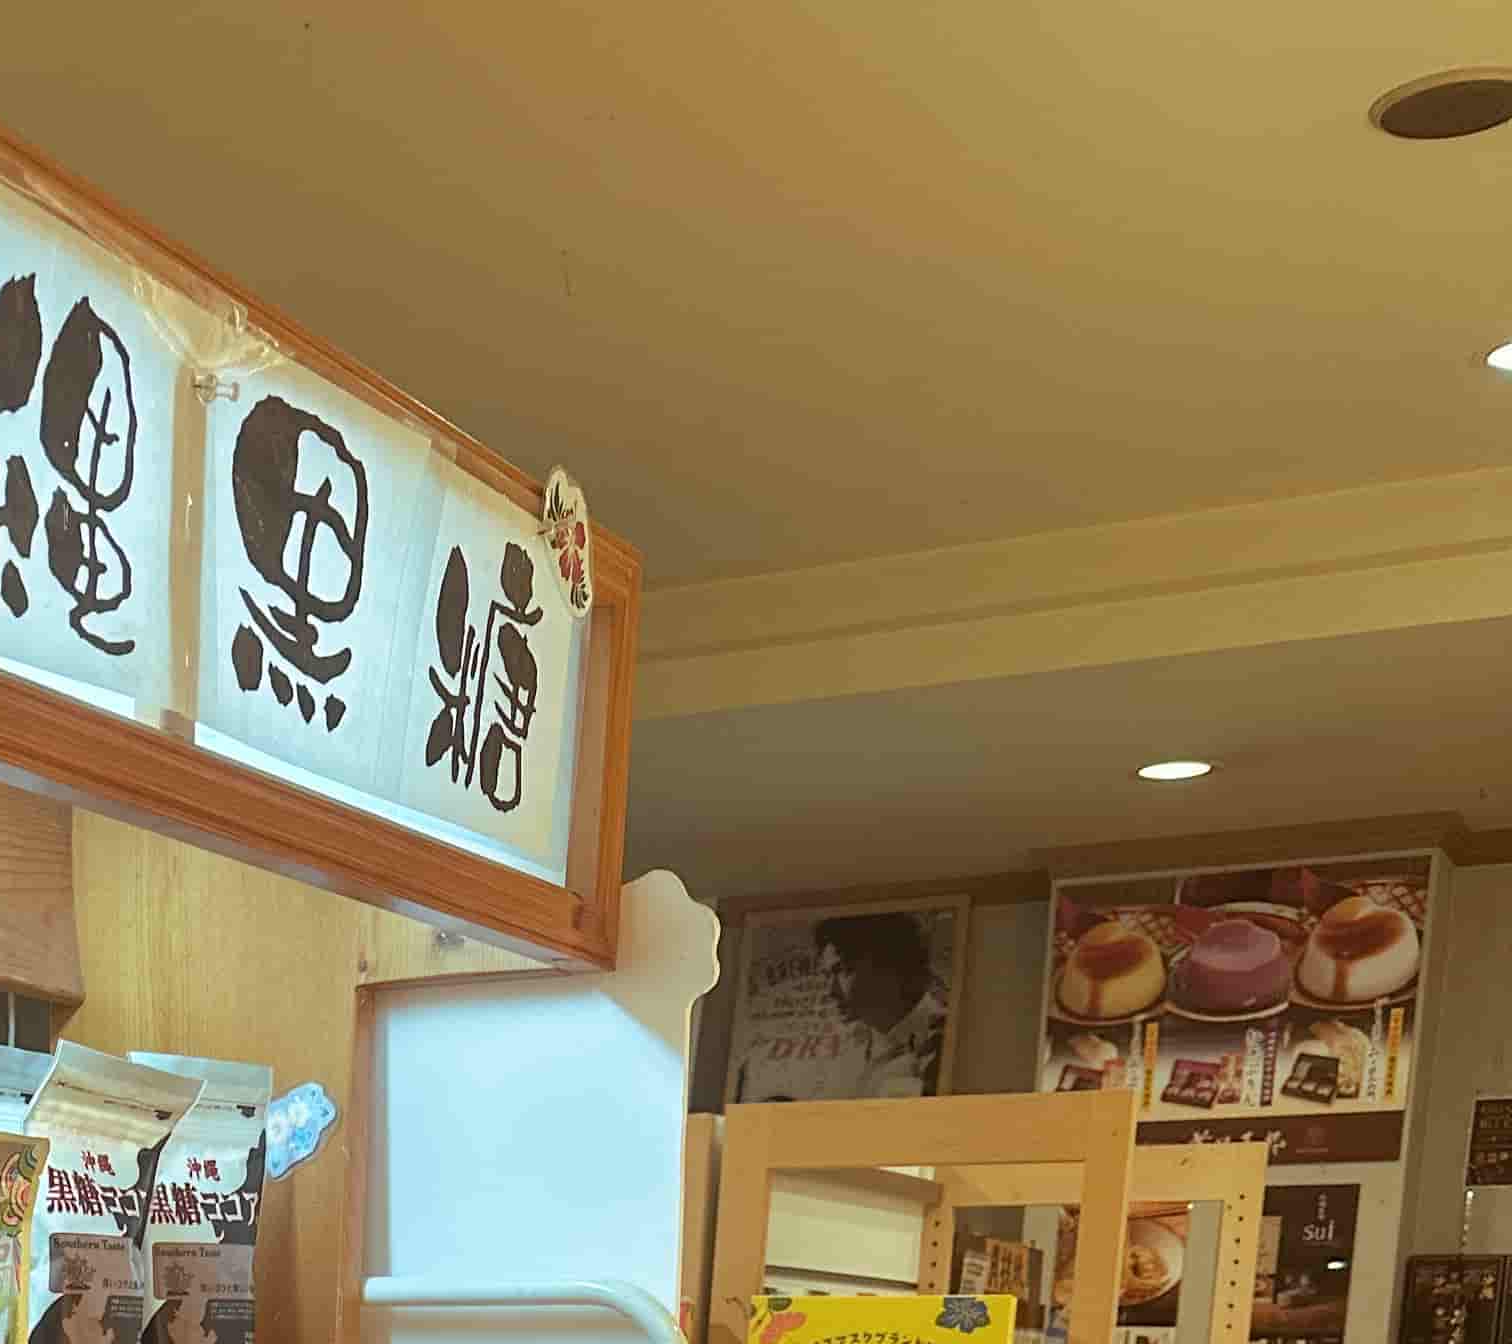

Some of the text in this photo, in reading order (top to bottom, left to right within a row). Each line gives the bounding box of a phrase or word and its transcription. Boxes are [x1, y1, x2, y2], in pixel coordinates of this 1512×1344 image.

[81, 1151, 116, 1176] 沖縄
[186, 1157, 221, 1181] 沖縄
[47, 1165, 146, 1217] 黒糖ココ
